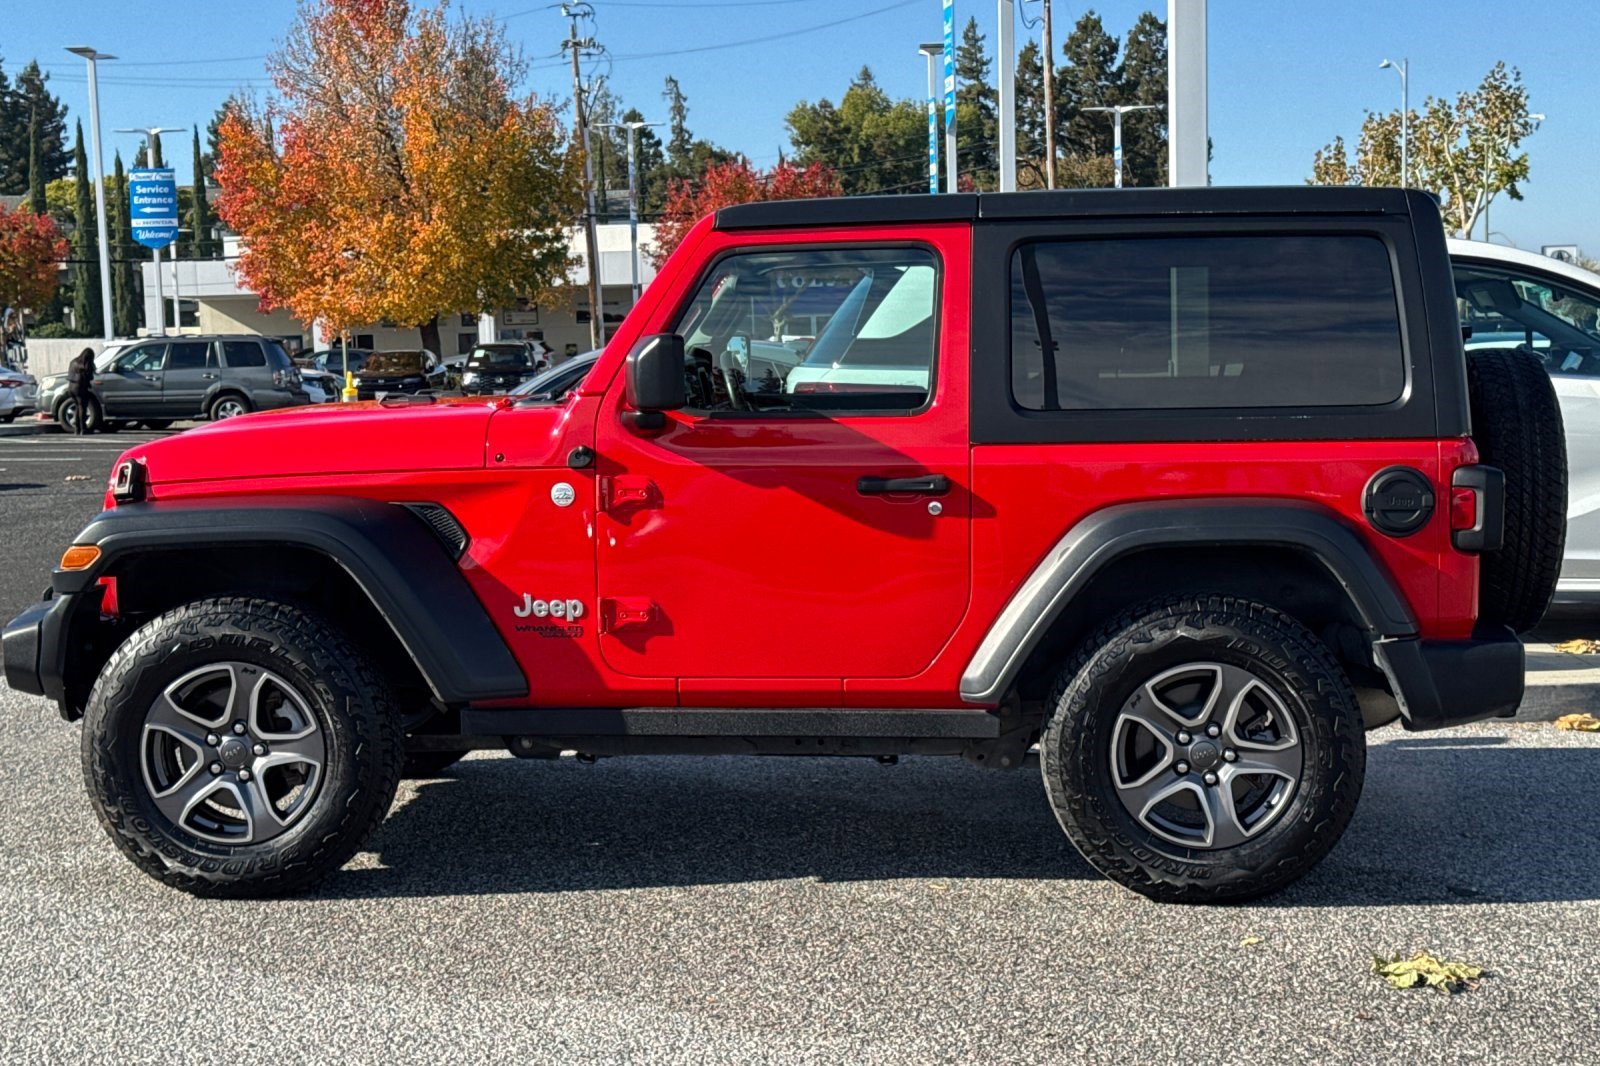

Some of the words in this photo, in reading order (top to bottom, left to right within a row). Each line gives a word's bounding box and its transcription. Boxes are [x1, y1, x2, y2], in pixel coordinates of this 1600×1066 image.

[135, 185, 170, 194] Service
[133, 196, 174, 205] Entrance
[136, 229, 174, 240] Welcome!
[513, 592, 584, 622] Jeep
[118, 785, 301, 877] BRIDGESTON
